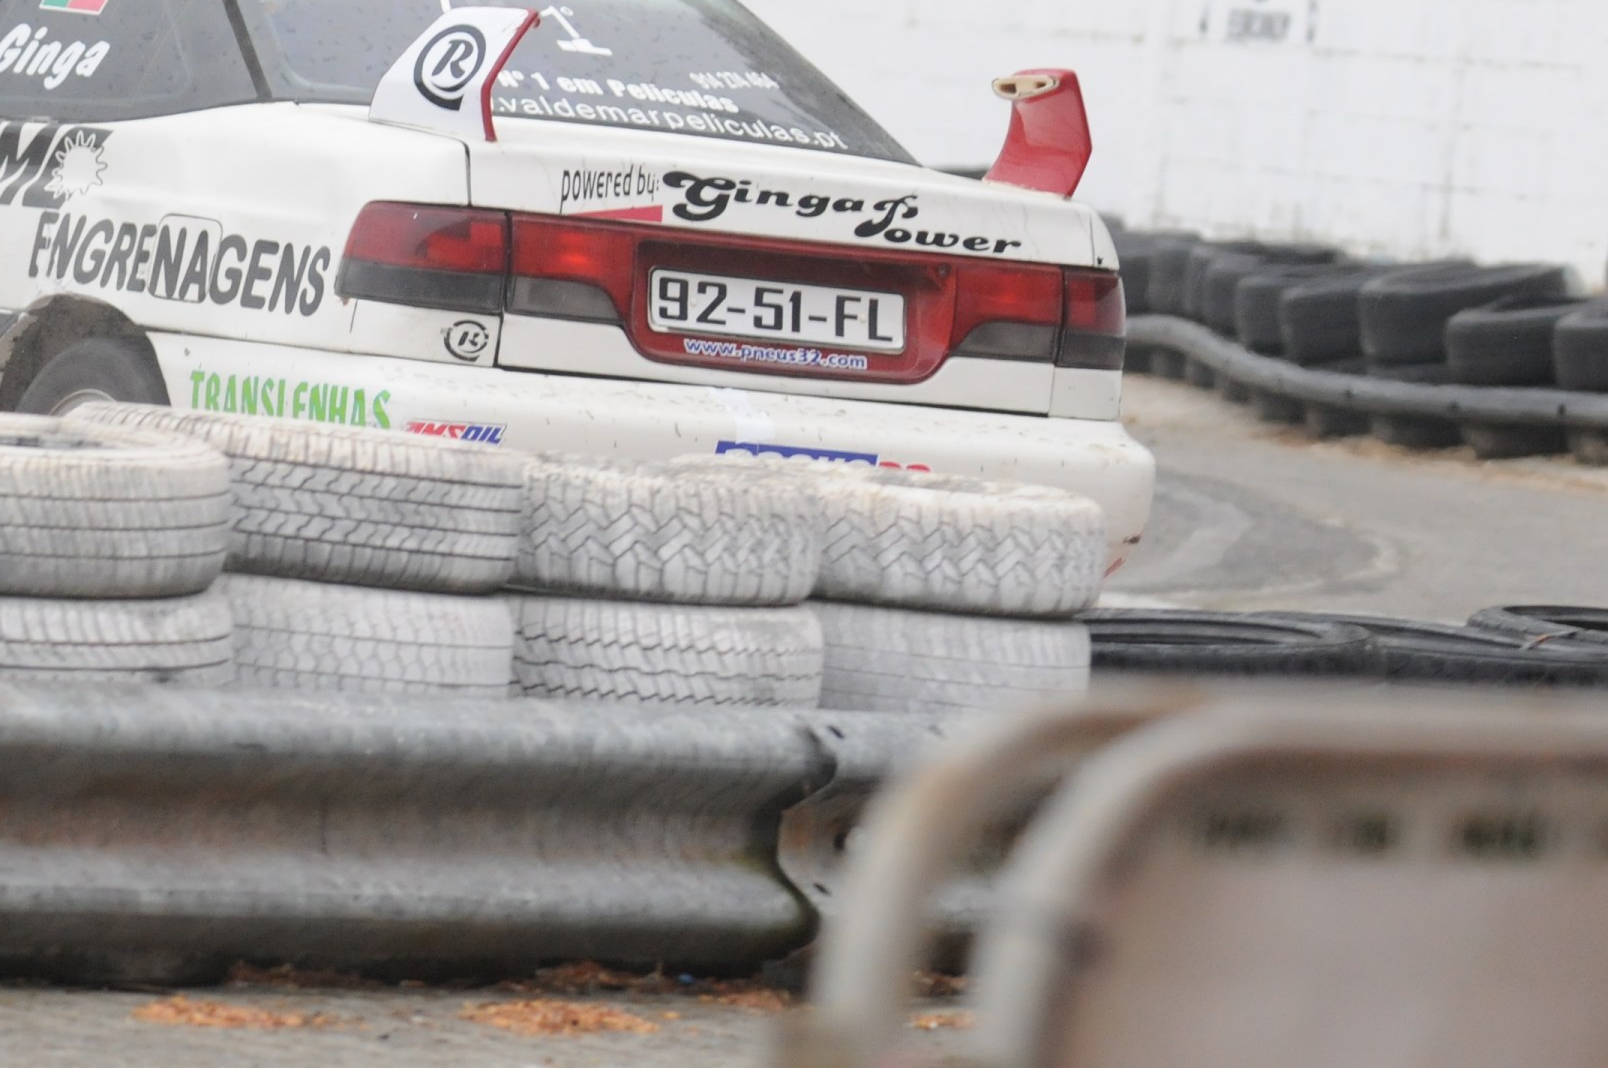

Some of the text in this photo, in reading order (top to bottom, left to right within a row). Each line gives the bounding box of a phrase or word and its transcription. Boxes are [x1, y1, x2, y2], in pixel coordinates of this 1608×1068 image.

[556, 76, 605, 96] em
[559, 164, 634, 216] powered
[662, 170, 1022, 254] Ginga Power
[28, 211, 331, 316] ENGRENAGENS
[658, 276, 893, 342] 92-51-FL
[683, 338, 868, 370] www.pneus32.com
